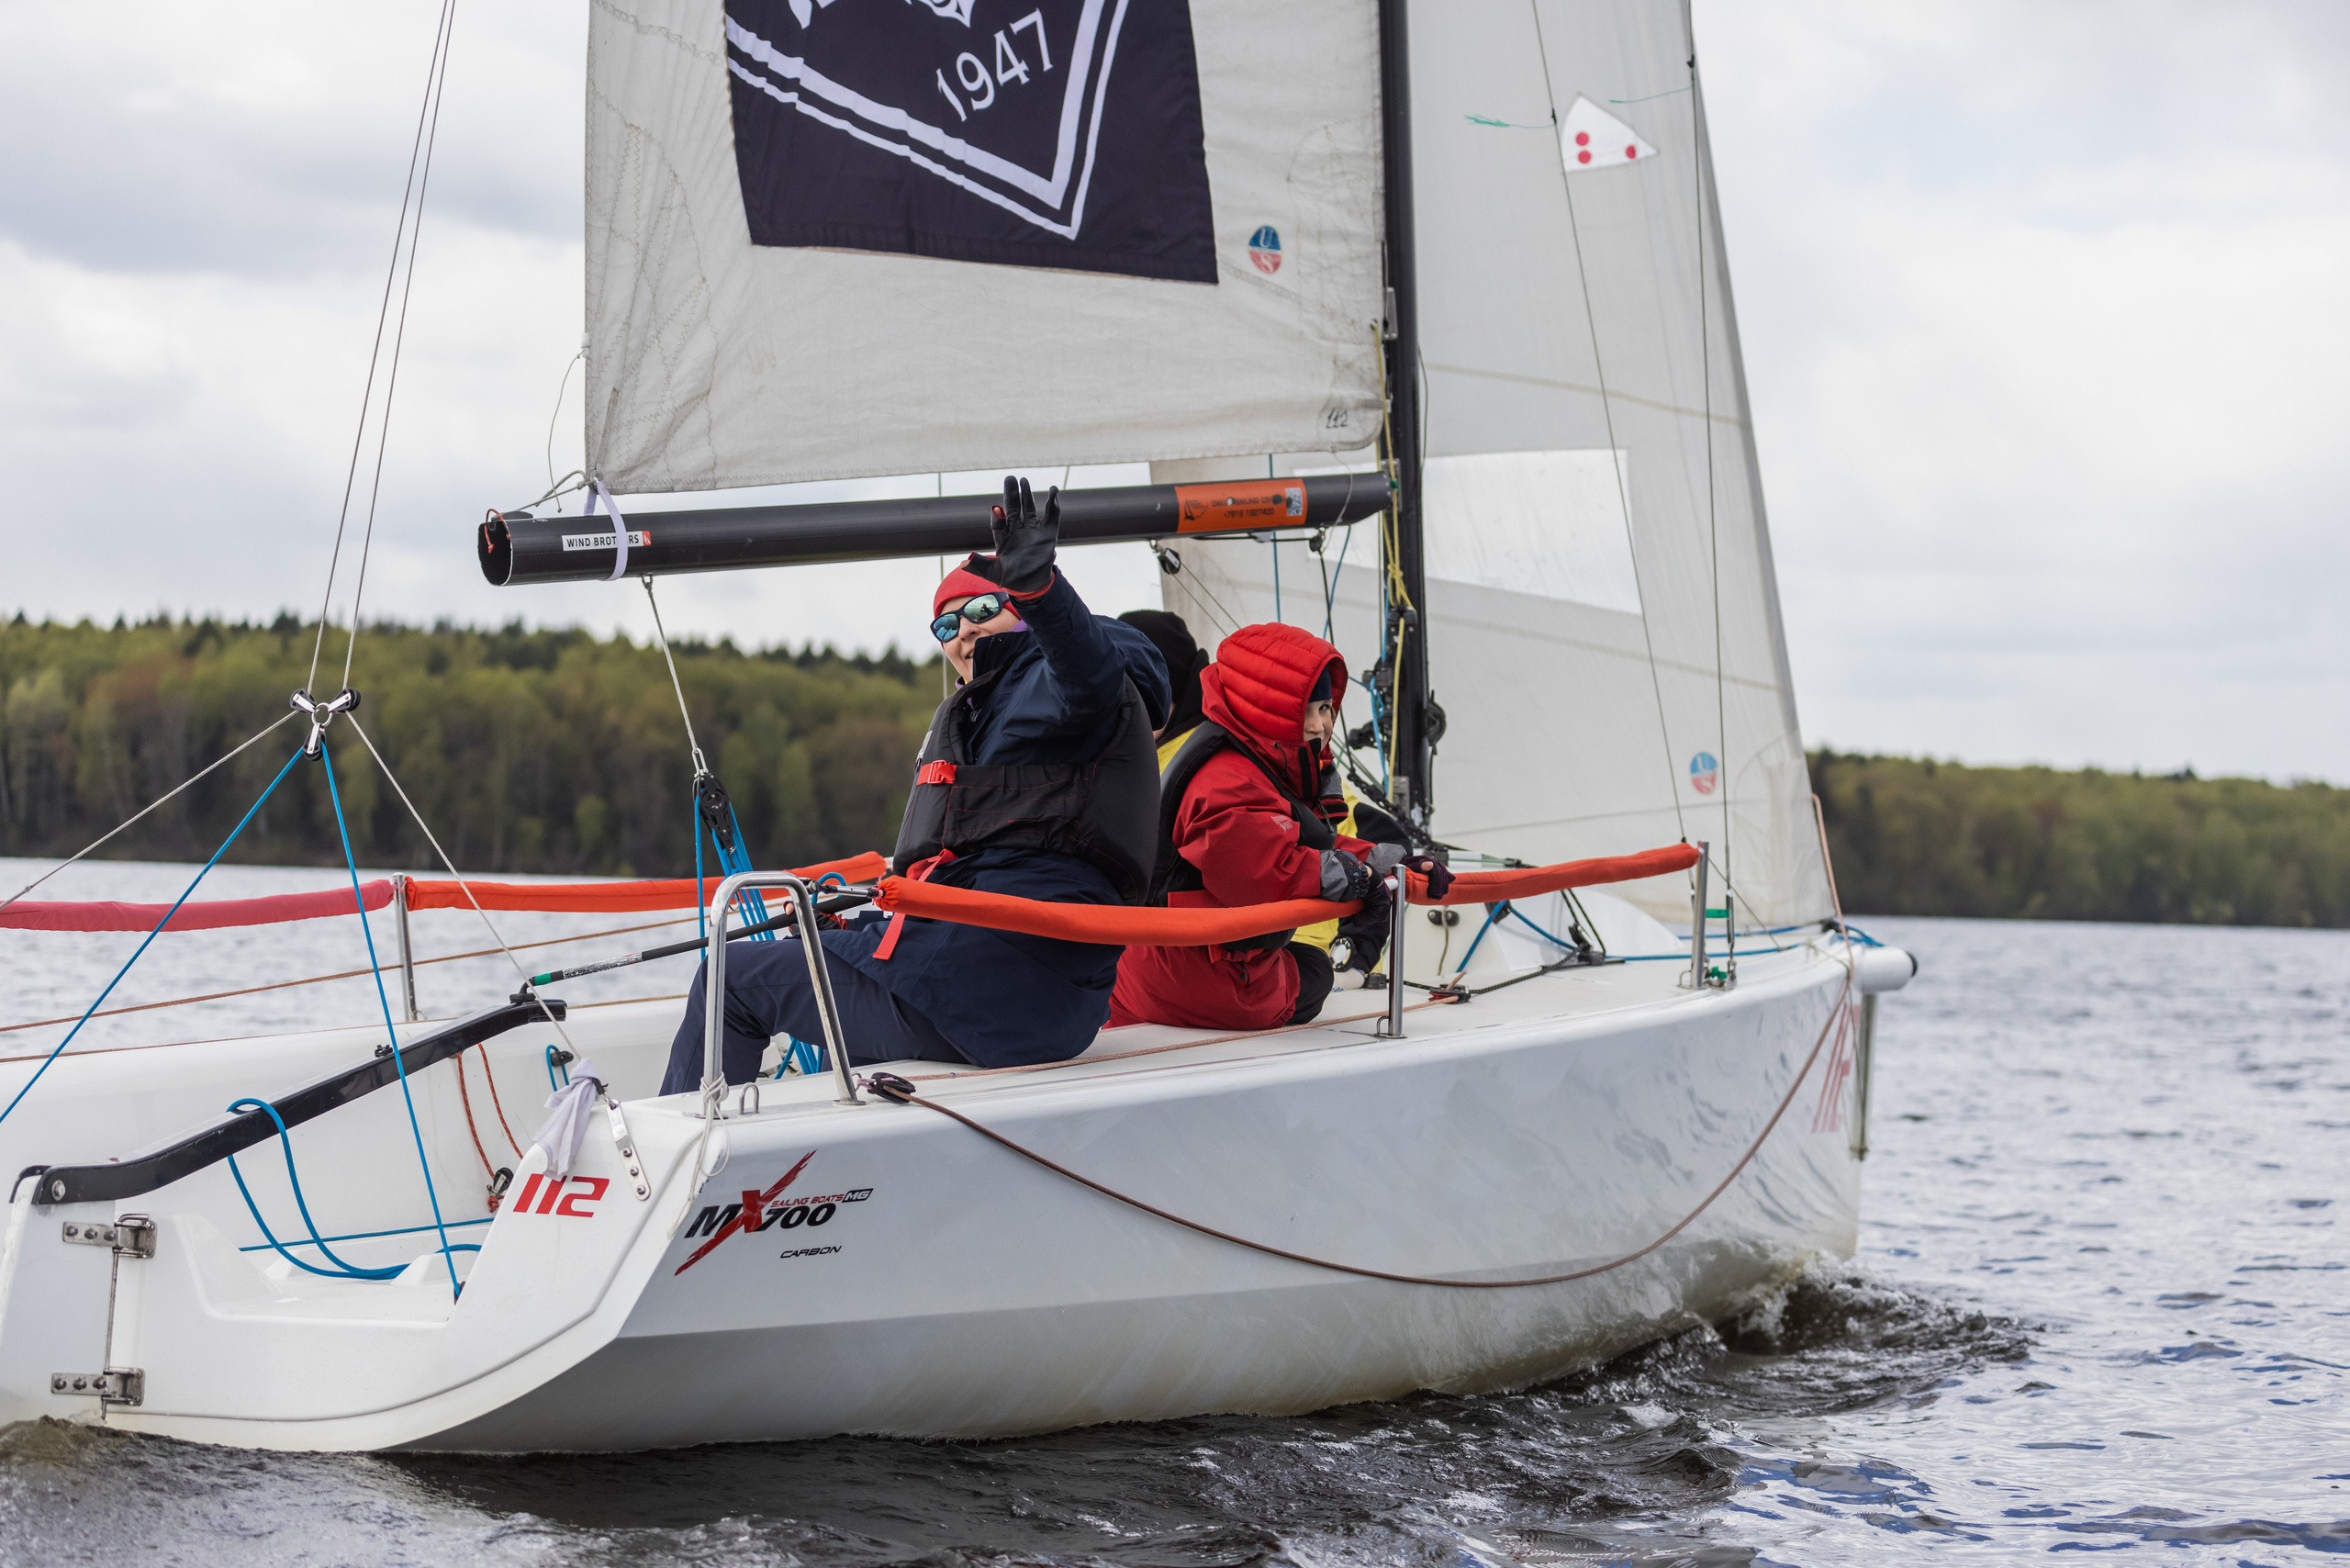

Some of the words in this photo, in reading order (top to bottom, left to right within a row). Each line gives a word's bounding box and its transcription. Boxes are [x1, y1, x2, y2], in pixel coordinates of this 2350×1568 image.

[935, 7, 1053, 122] 1947
[566, 538, 591, 548] WIND
[594, 534, 639, 547] BROTRS
[512, 1173, 610, 1218] 112
[770, 1197, 810, 1208] SAILING
[811, 1193, 845, 1204] BOATS
[843, 1189, 872, 1203] MG
[779, 1245, 843, 1259] CARBON
